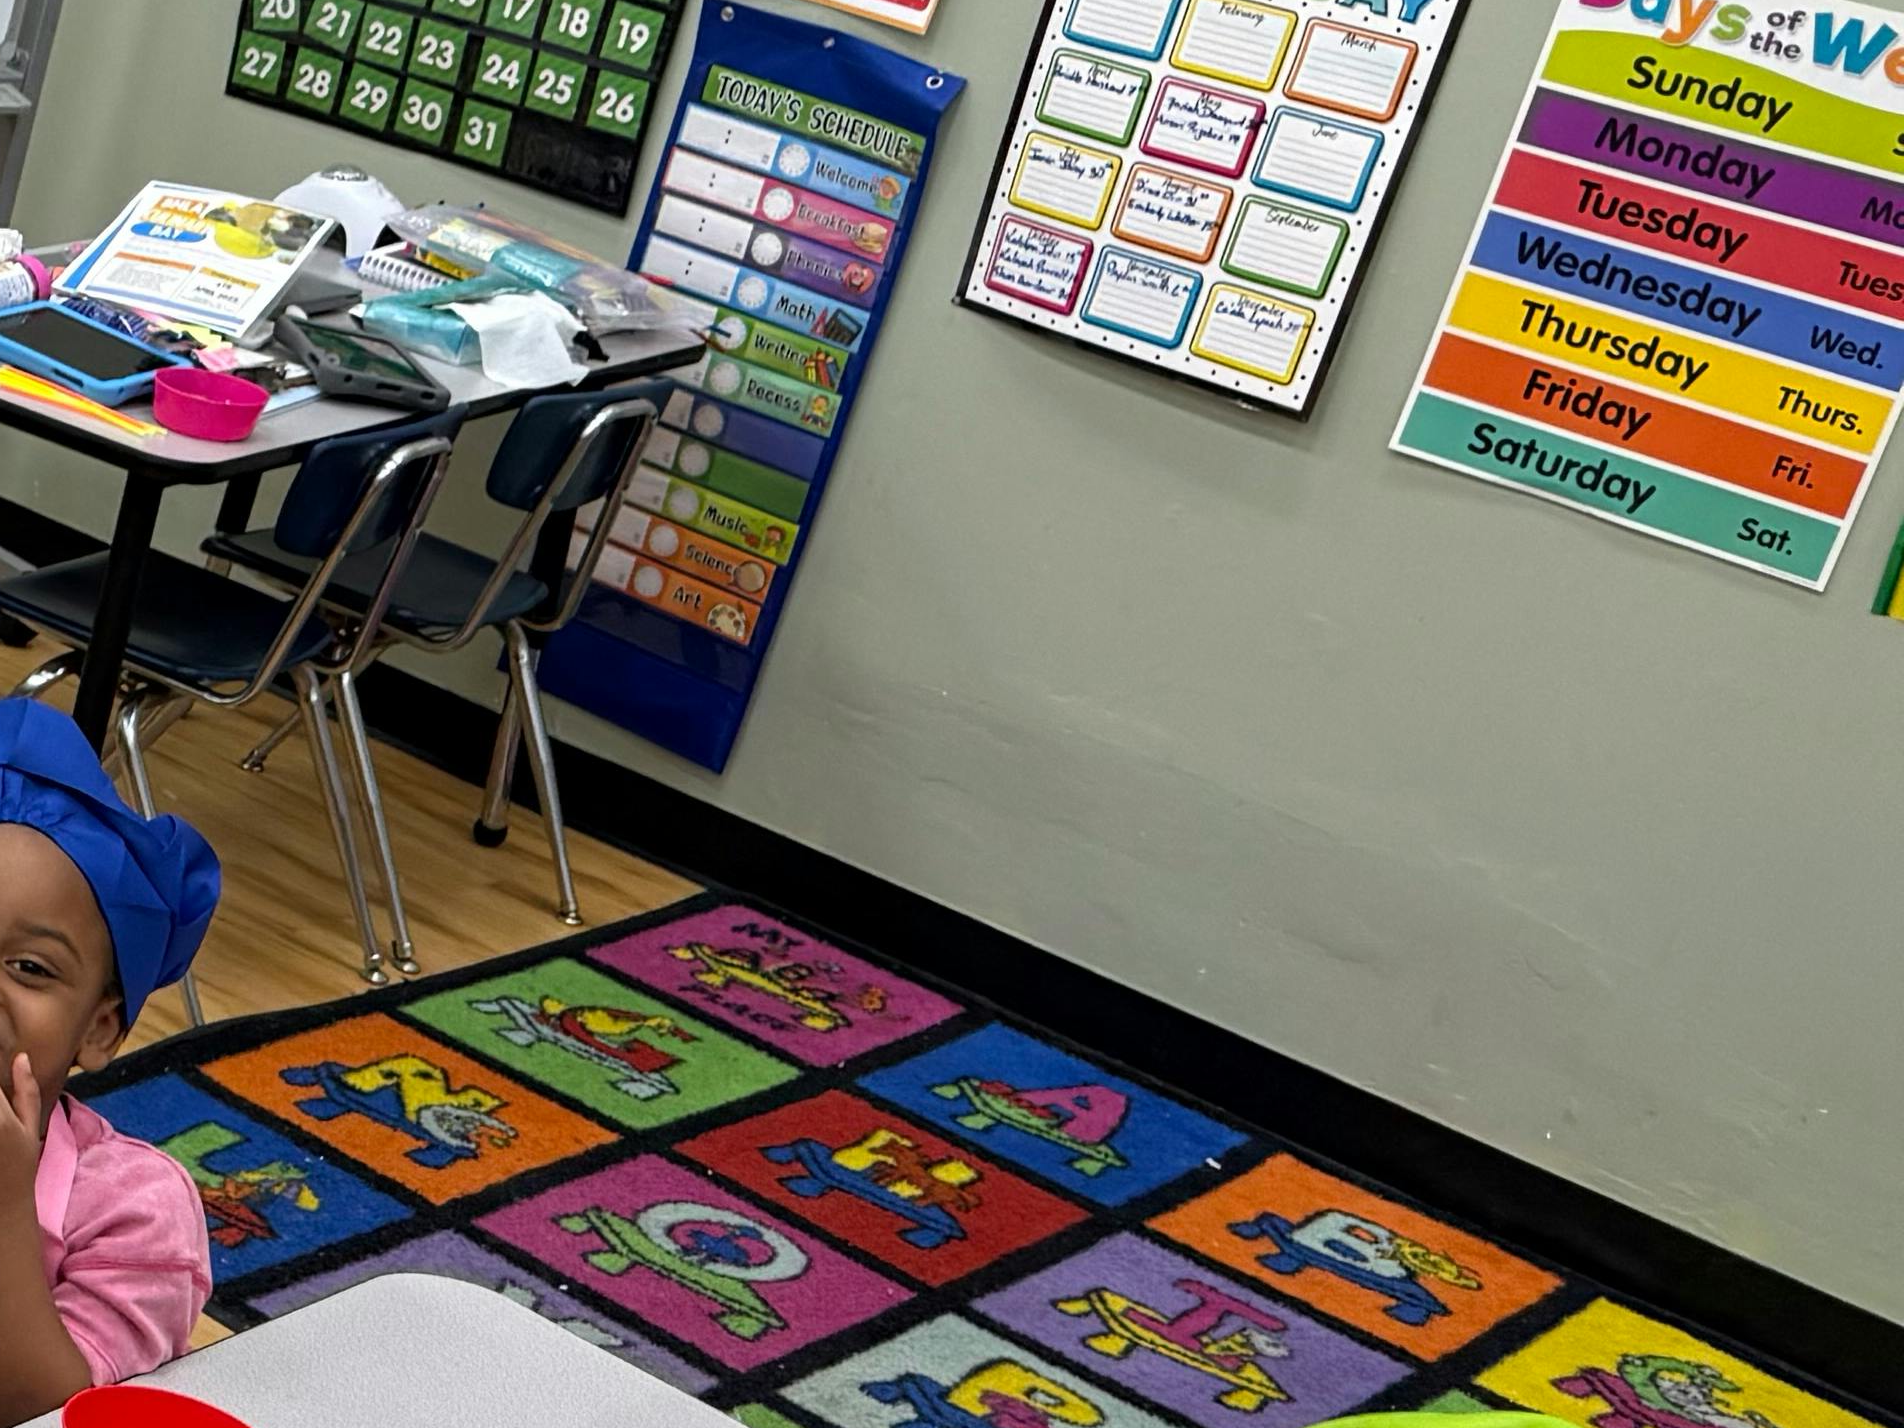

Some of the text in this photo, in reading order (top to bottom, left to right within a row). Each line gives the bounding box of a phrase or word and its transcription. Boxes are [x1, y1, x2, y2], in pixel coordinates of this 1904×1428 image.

[558, 2, 591, 39] 18
[616, 17, 651, 54] 19
[1218, 1, 1267, 28] February
[1340, 32, 1378, 53] March
[1749, 31, 1803, 62] the
[1766, 9, 1807, 31] of
[241, 46, 498, 152] 27 28 29 30 31
[316, 1, 352, 39] 21
[364, 20, 403, 57] 22
[417, 34, 456, 70] 23
[481, 53, 521, 90] 24
[533, 67, 576, 105] 25
[595, 86, 635, 124] 26
[1626, 55, 1795, 134] Sunday
[716, 73, 911, 160] TODAY'S SCHEDULE
[1594, 117, 1777, 200] Monday
[1263, 206, 1320, 234] September
[1576, 178, 1750, 264] Tuesday
[775, 294, 817, 323] Math
[1516, 230, 1884, 370] Wednesday Wed.
[746, 377, 803, 412] Recess
[1519, 298, 1865, 436] Thursday Thurs.
[1521, 368, 1815, 491] Friday Fri.
[702, 505, 751, 537] Music
[1466, 422, 1794, 558] Saturday Sat.
[671, 585, 704, 611] Art
